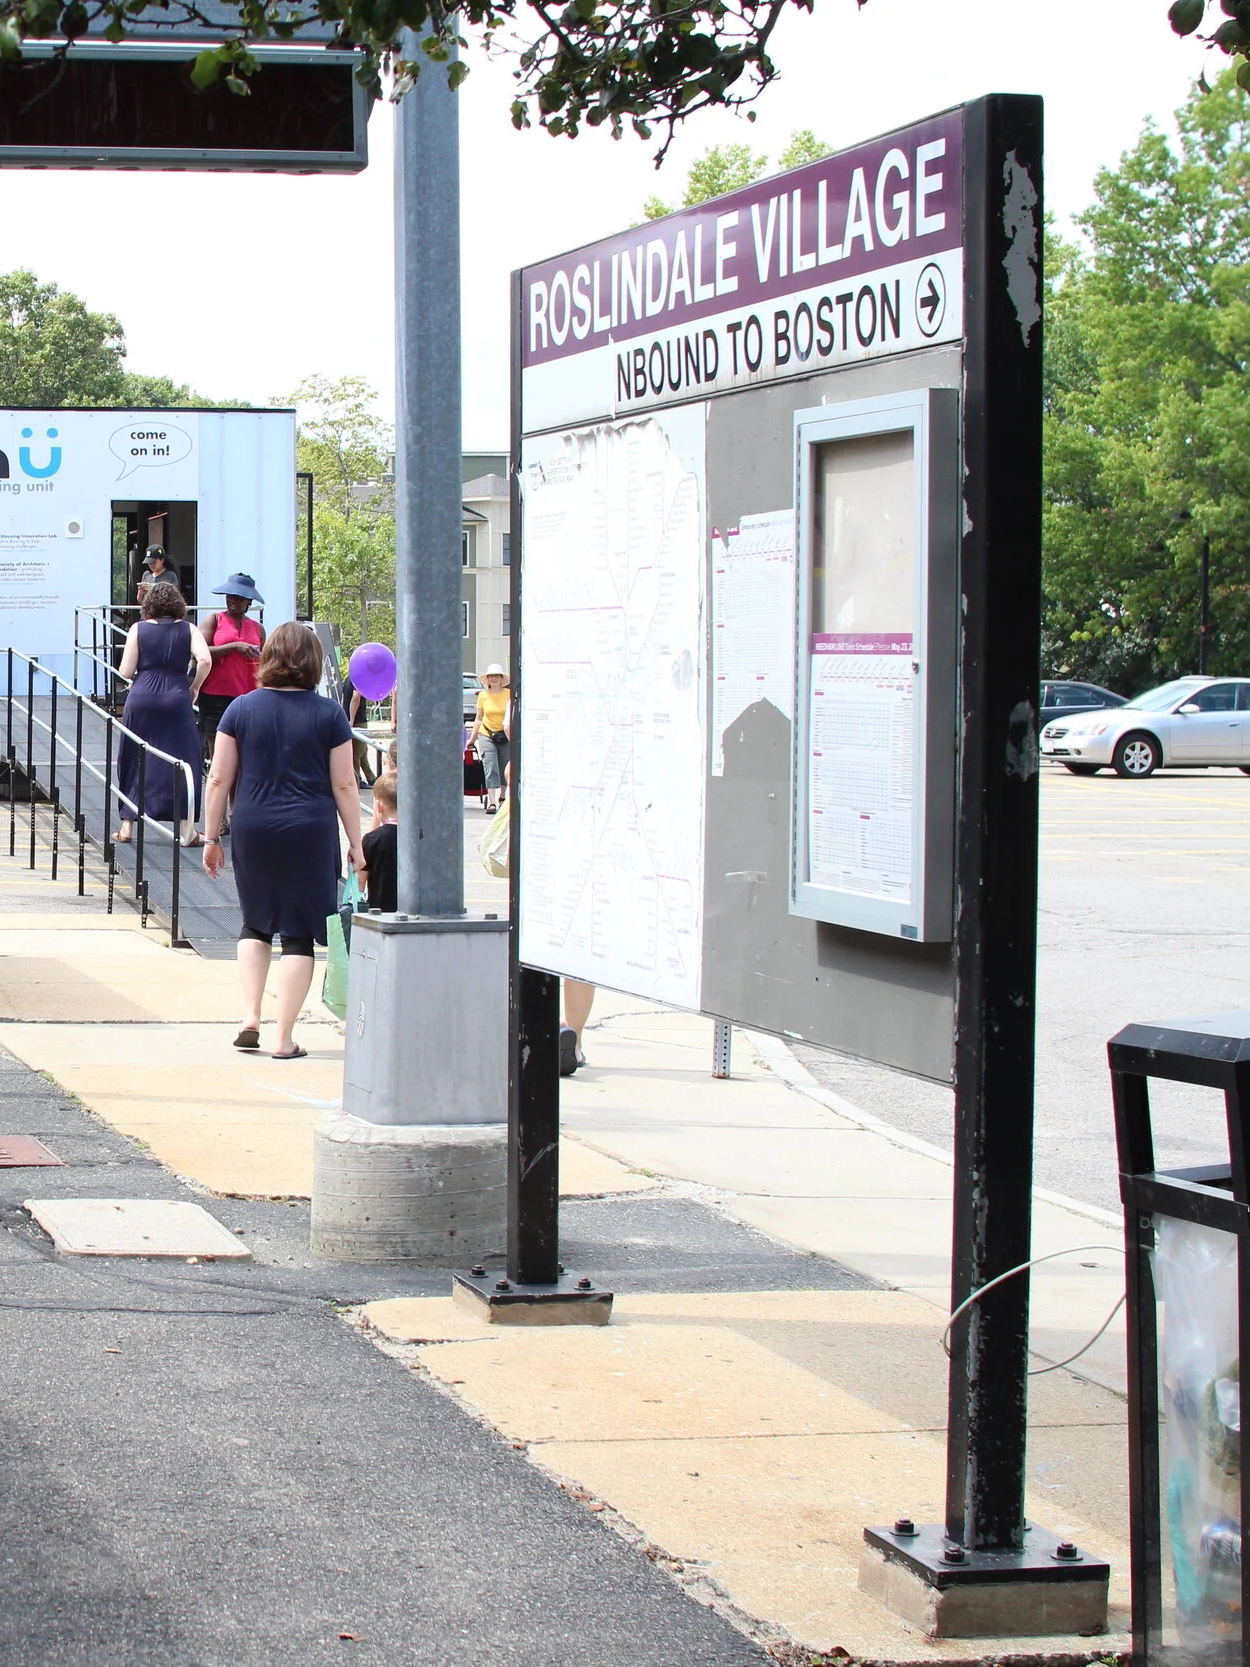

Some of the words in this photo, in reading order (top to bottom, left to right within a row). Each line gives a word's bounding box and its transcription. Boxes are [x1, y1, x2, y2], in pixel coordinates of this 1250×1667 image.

[529, 209, 739, 352] ROSLINDALE
[751, 137, 947, 284] VILLAGE
[726, 313, 763, 373] TO
[775, 279, 901, 366] BOSTON
[130, 431, 167, 440] come
[130, 447, 148, 456] on
[152, 444, 170, 456] in!
[27, 480, 54, 492] unit
